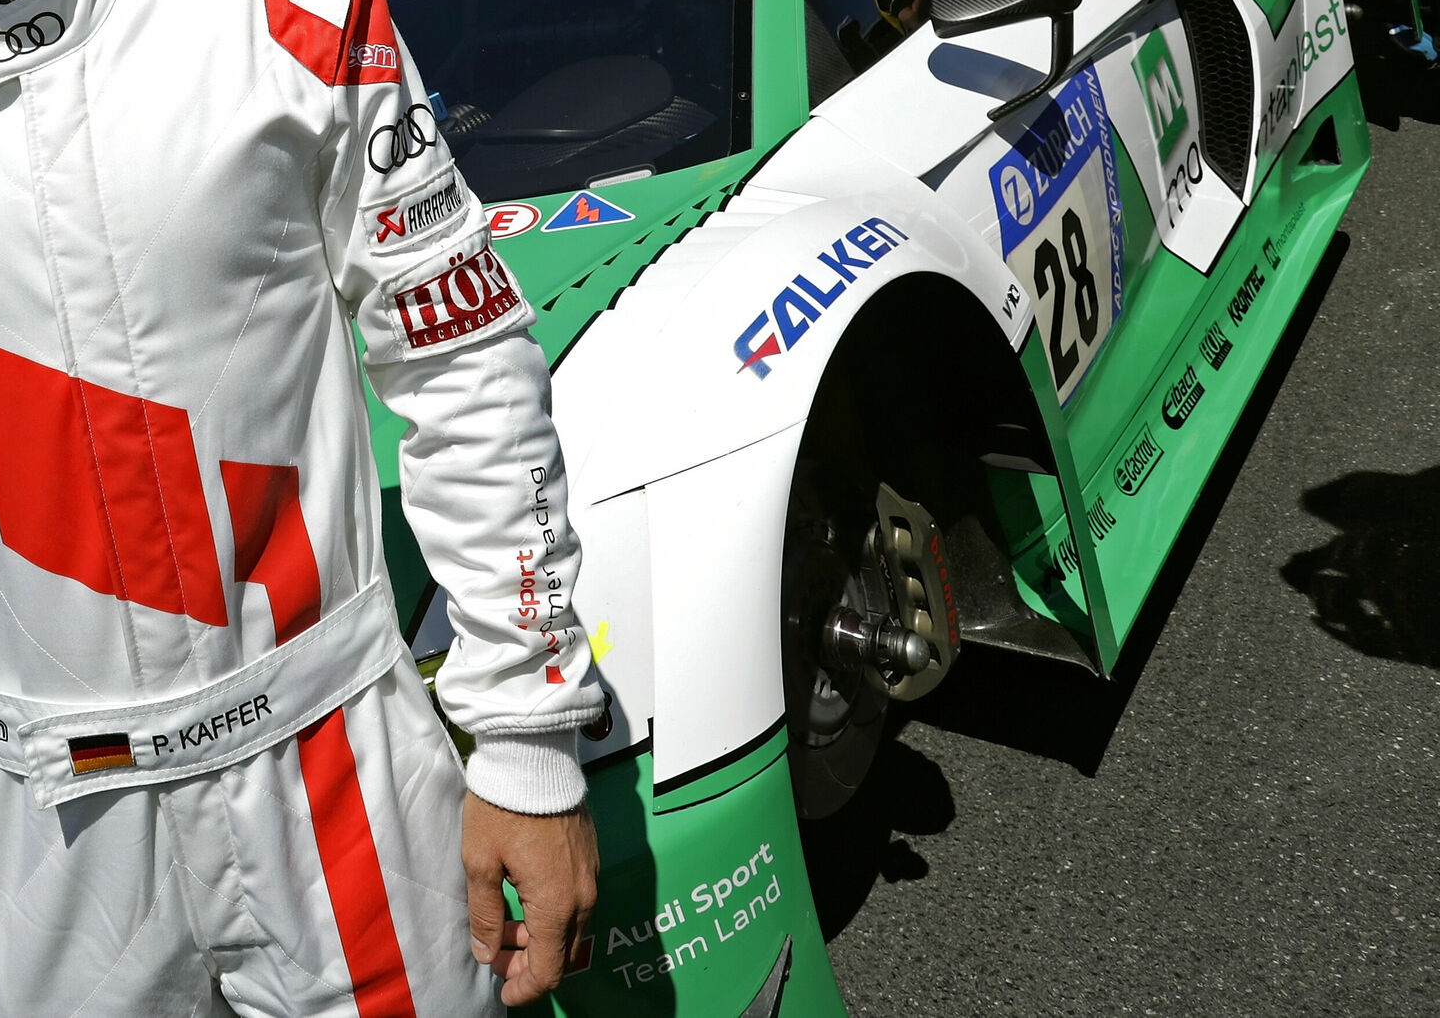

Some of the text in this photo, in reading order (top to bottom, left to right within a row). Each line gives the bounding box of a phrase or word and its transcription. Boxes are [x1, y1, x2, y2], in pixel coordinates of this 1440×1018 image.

[1025, 96, 1093, 198] ZURICH
[1090, 70, 1124, 311] ADAC NORDRHEIN
[400, 250, 510, 332] HÖR
[411, 290, 519, 347] TECHNOLOGIE
[733, 216, 909, 382] FALKEN
[1033, 207, 1099, 392] 28
[1127, 431, 1159, 484] Castrol
[530, 466, 556, 557] racing
[152, 693, 274, 756] P. KAFFER
[606, 843, 775, 955] Audi Sport
[612, 874, 782, 989] Team Land
